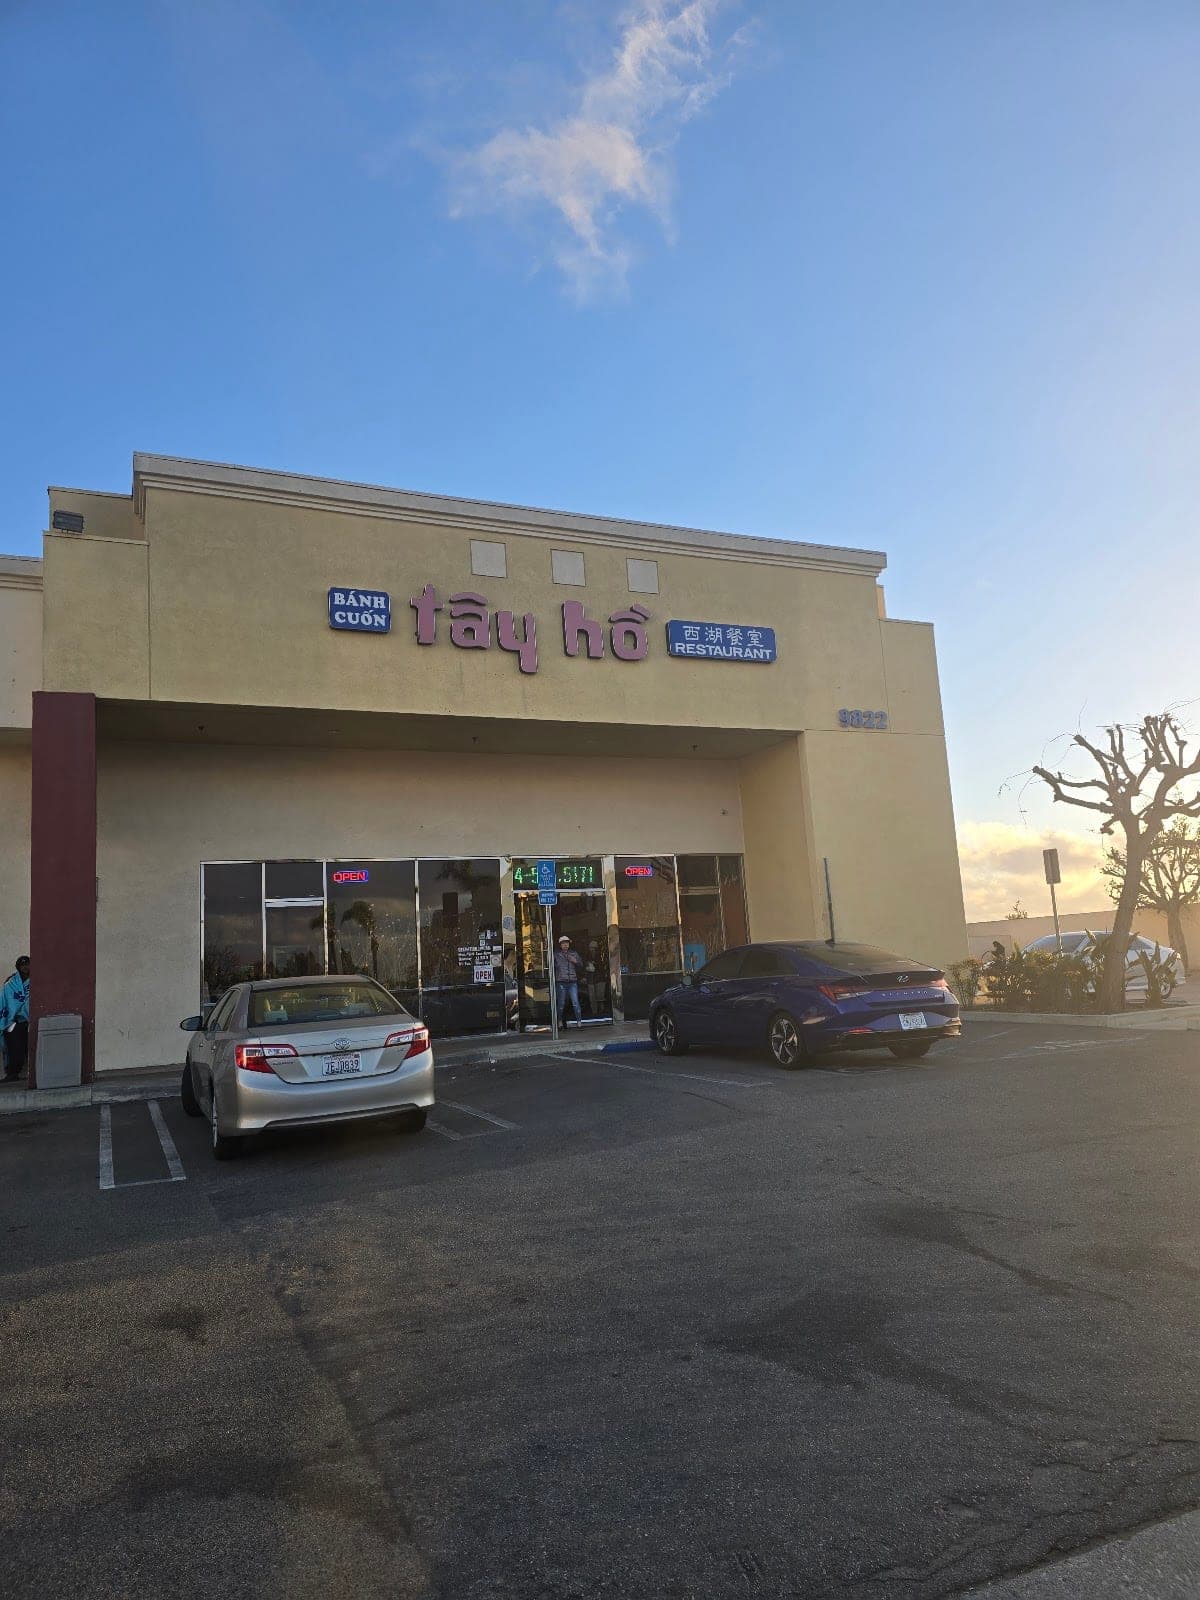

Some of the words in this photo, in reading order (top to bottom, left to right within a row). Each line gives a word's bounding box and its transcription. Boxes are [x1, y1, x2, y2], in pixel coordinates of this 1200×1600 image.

[334, 591, 386, 609] BÁNH
[334, 610, 387, 627] CUỐN
[410, 584, 539, 674] tây
[562, 600, 652, 660] hồ
[682, 625, 765, 648] 西湖餐室
[675, 642, 772, 660] RESTAURANT
[838, 708, 888, 729] 9822
[333, 871, 366, 882] OPEN
[625, 866, 651, 876] OPEN
[475, 970, 492, 980] OPEN
